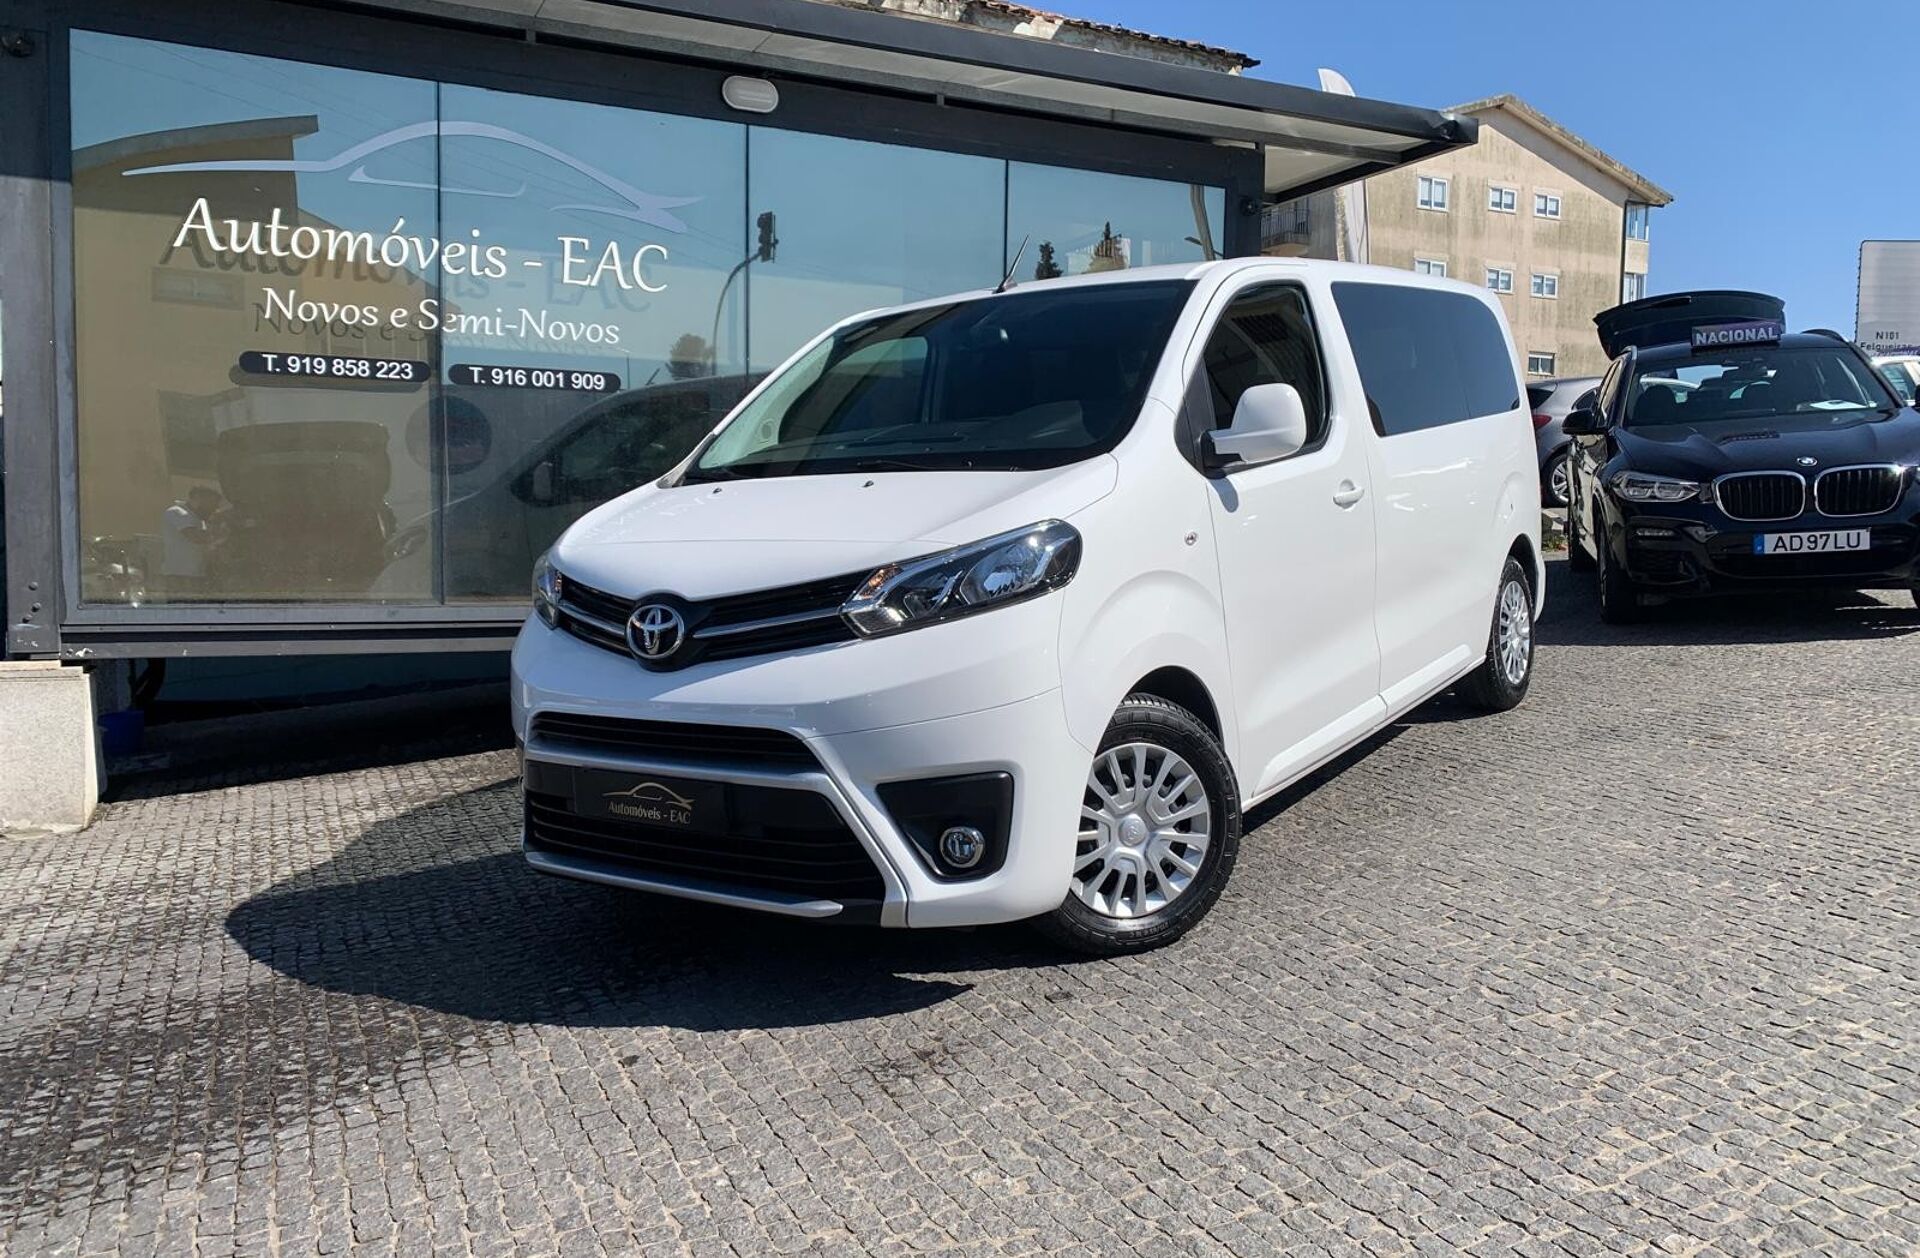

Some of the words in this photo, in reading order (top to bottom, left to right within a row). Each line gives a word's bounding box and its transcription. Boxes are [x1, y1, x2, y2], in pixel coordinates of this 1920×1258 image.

[172, 197, 507, 279] Automóveis
[557, 236, 668, 292] EAC
[262, 287, 379, 327] Novos
[390, 306, 408, 328] e
[418, 298, 620, 344] Semi-Novos
[1695, 327, 1778, 345] NACIONAL
[262, 353, 281, 373] T.
[287, 355, 326, 375] 919
[331, 358, 370, 377] 858
[375, 361, 414, 380] 223
[469, 366, 486, 384] T.
[491, 368, 527, 386] 916
[531, 370, 565, 388] 001
[571, 373, 605, 390] 909
[608, 801, 661, 820] Automóveis
[670, 809, 691, 824] EAC
